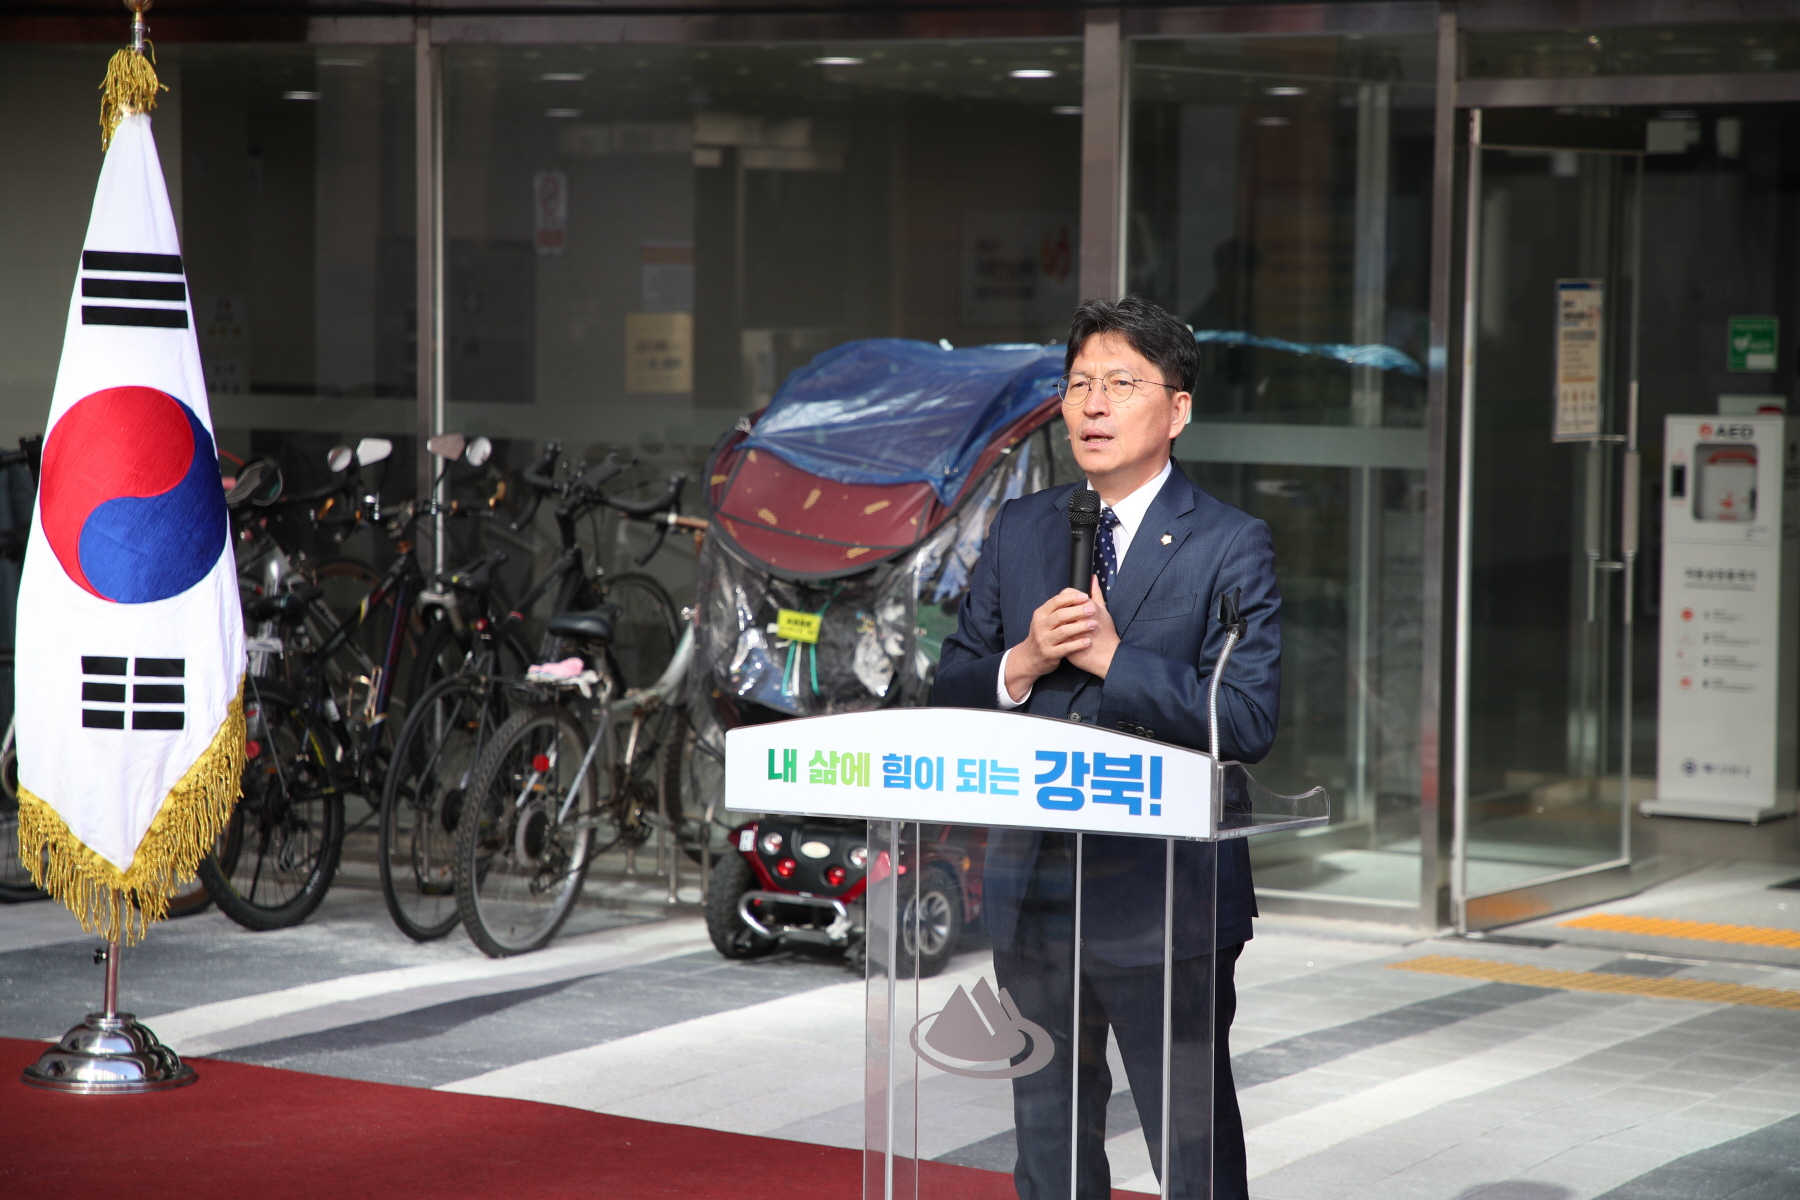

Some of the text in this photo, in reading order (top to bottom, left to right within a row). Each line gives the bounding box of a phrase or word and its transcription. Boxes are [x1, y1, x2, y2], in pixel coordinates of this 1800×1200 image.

[1716, 425, 1754, 439] AED
[768, 748, 1163, 817] 내 삶에 힘이 되는 강북!
